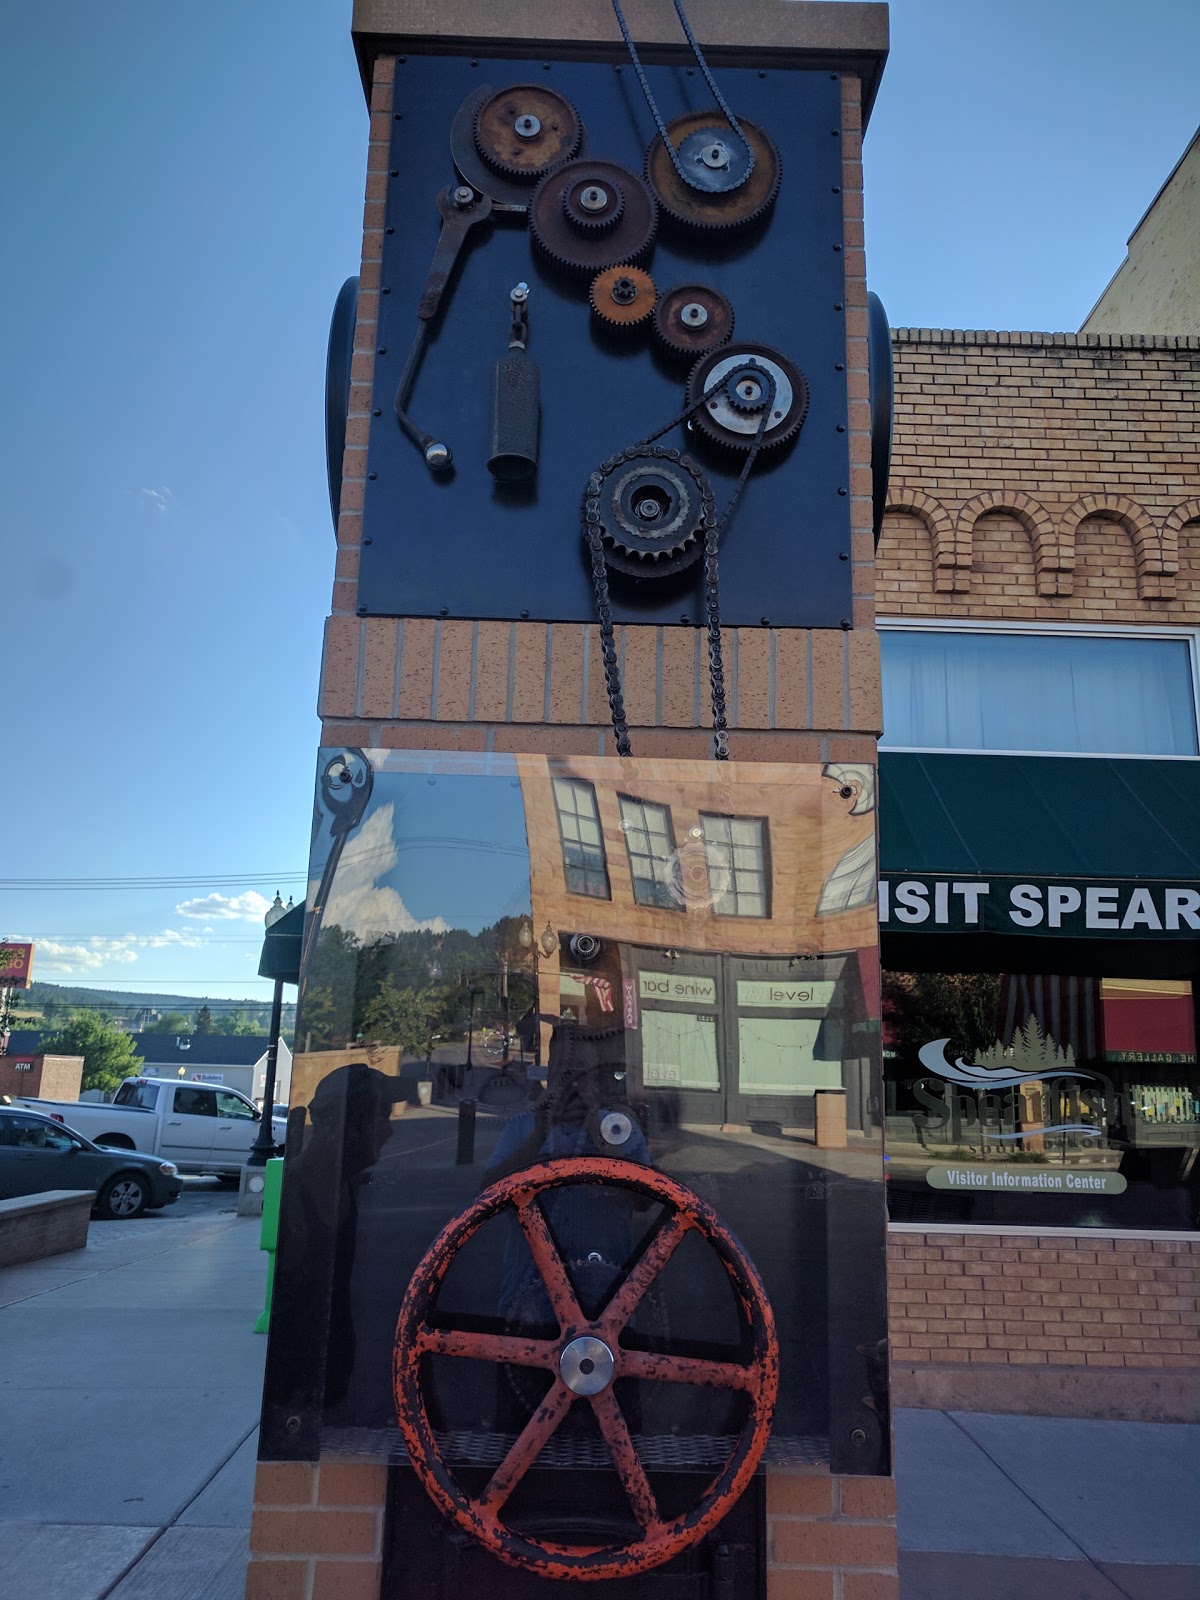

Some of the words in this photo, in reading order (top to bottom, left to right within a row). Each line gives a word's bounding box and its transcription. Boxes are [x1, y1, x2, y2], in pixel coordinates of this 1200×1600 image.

[1008, 884, 1200, 931] SPEAR
[201, 1074, 222, 1082] Builders
[912, 1069, 1131, 1147] Spearfish
[969, 1142, 1031, 1154] SOUTH
[947, 1170, 988, 1185] Visitor
[991, 1172, 1062, 1188] Information
[1066, 1174, 1106, 1189] Center
